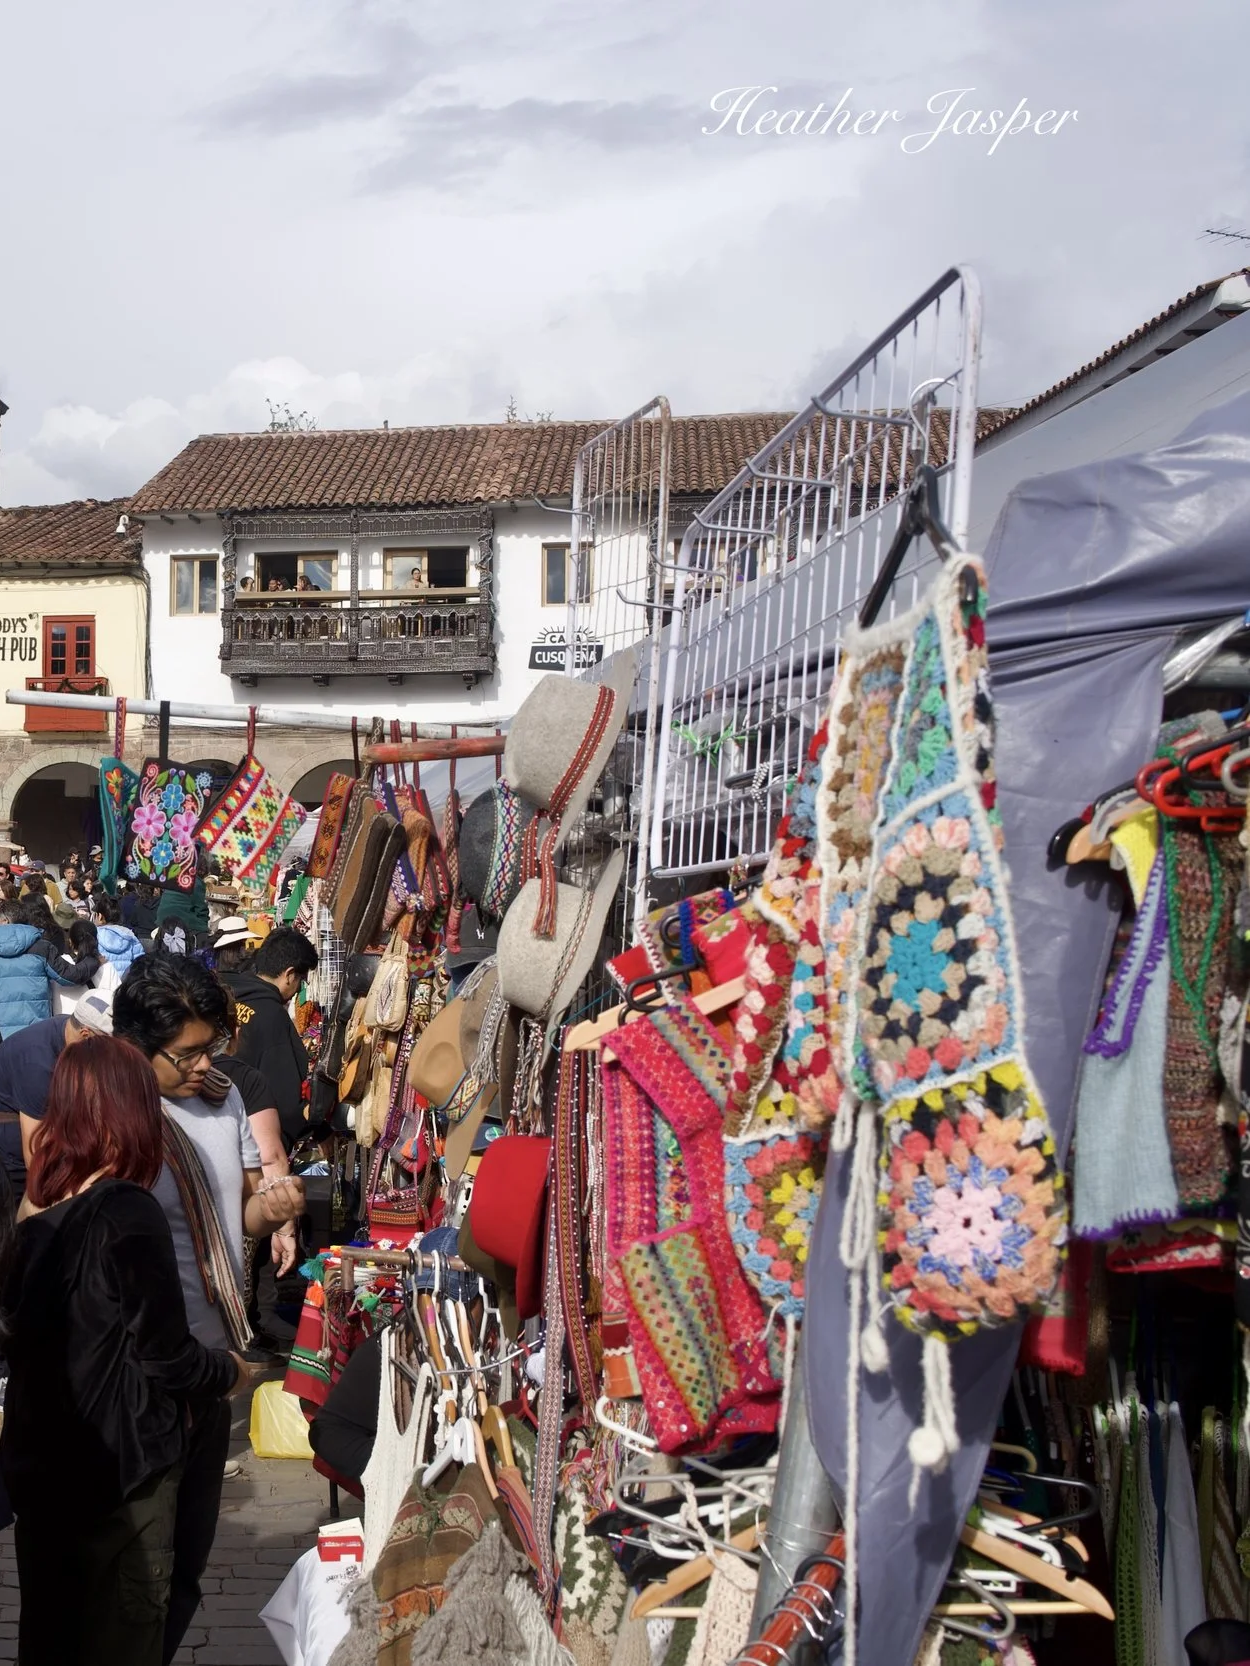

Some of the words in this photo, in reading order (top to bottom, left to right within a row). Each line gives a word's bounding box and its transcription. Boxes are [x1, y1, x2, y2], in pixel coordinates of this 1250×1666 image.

[10, 636, 37, 661] PUB
[549, 634, 582, 644] CAA
[534, 646, 597, 665] CUSQEÑA
